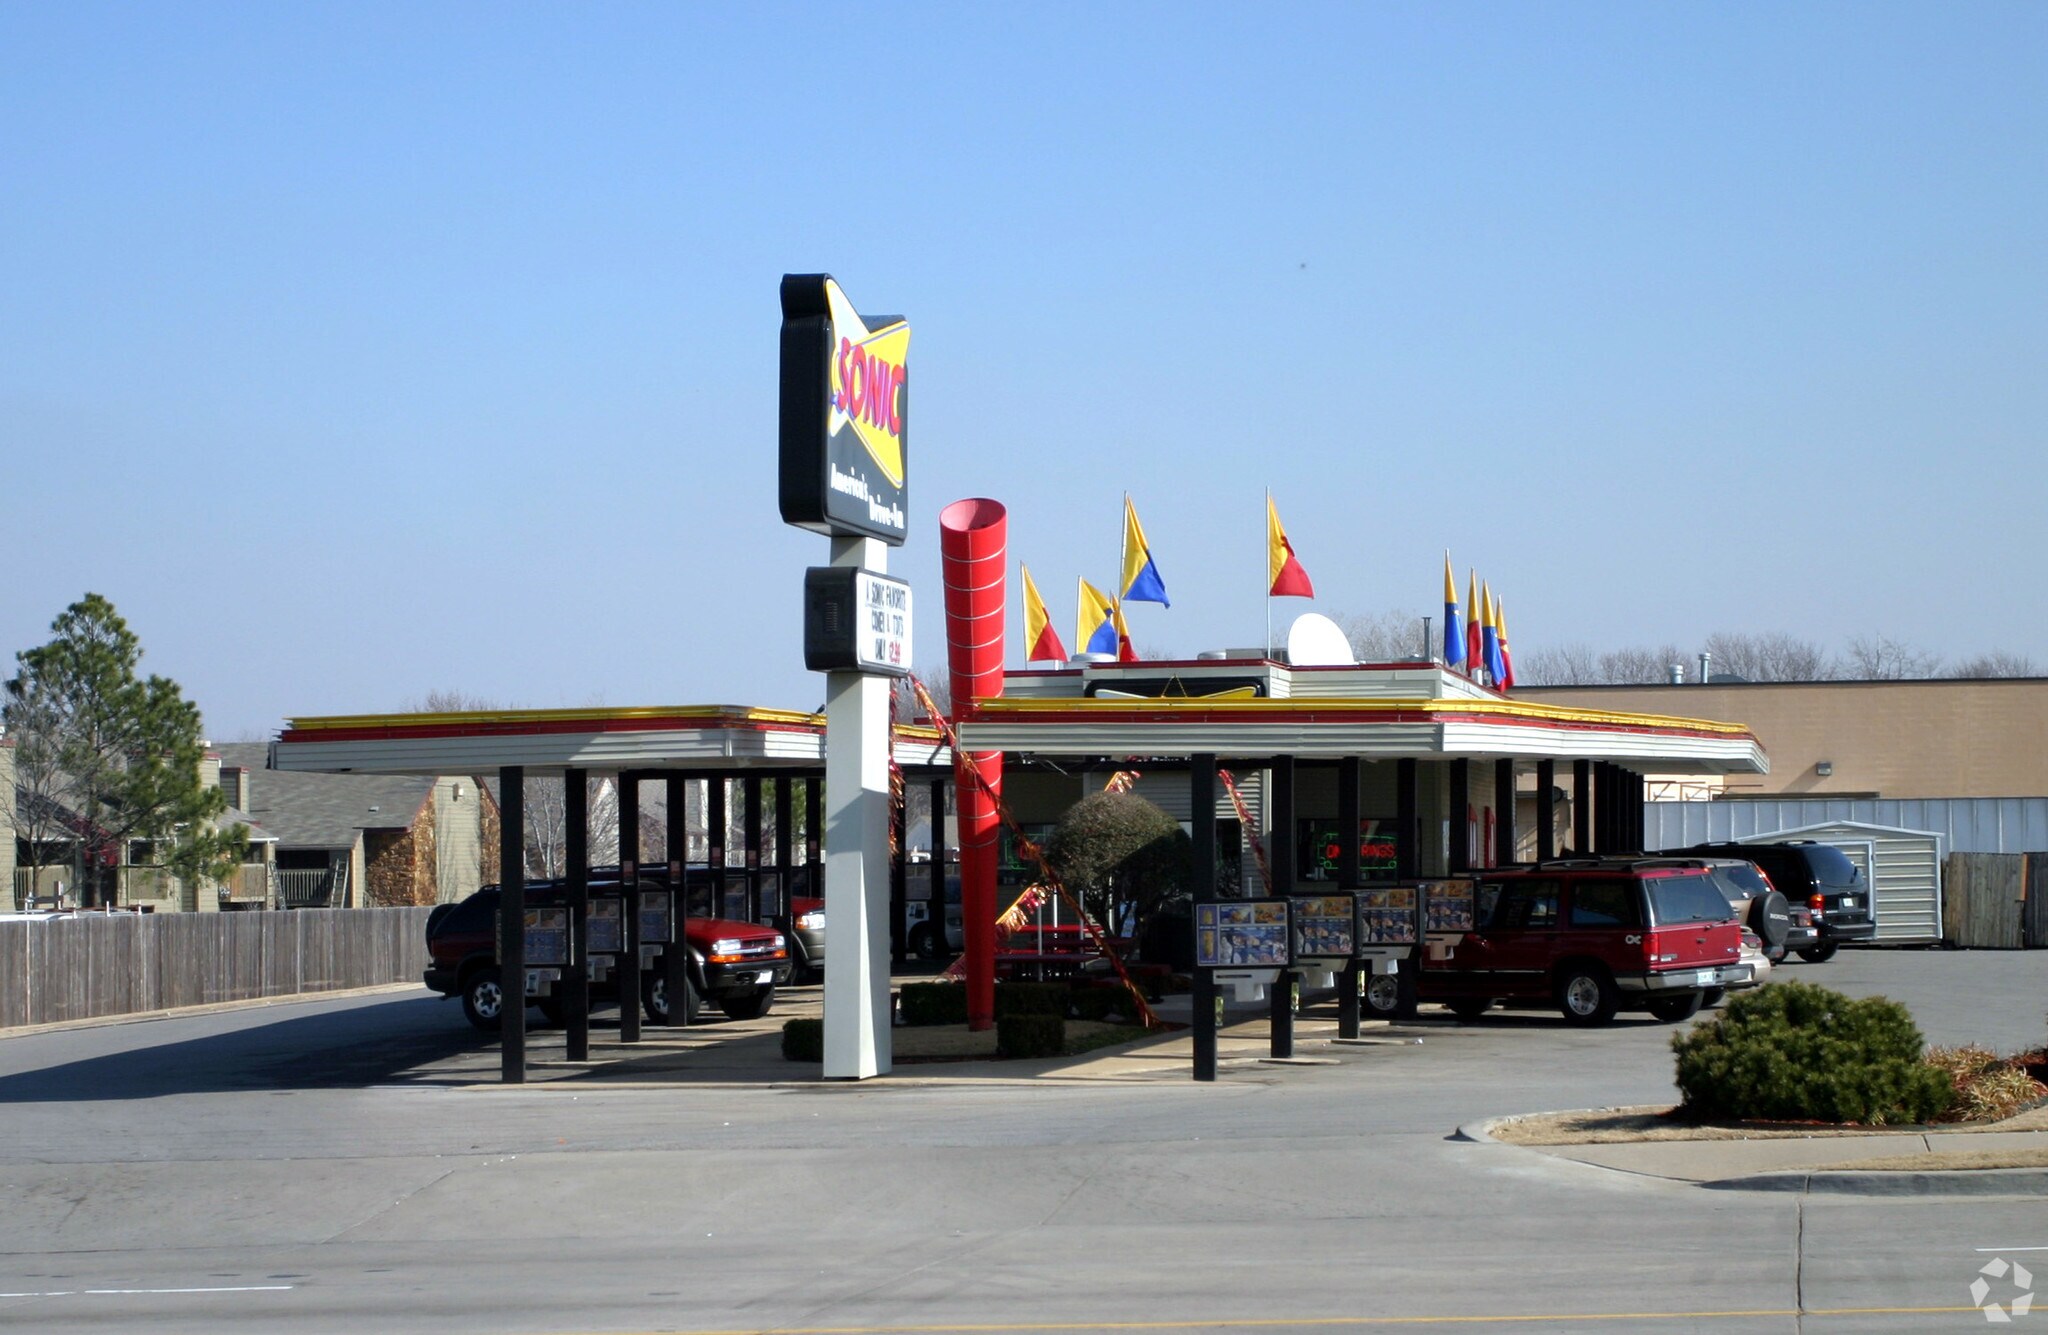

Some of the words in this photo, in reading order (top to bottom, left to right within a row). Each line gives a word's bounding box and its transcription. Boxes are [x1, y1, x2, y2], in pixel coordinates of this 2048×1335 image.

[835, 337, 905, 436] SONIC
[830, 462, 869, 501] America's
[868, 495, 904, 529] Drive-In
